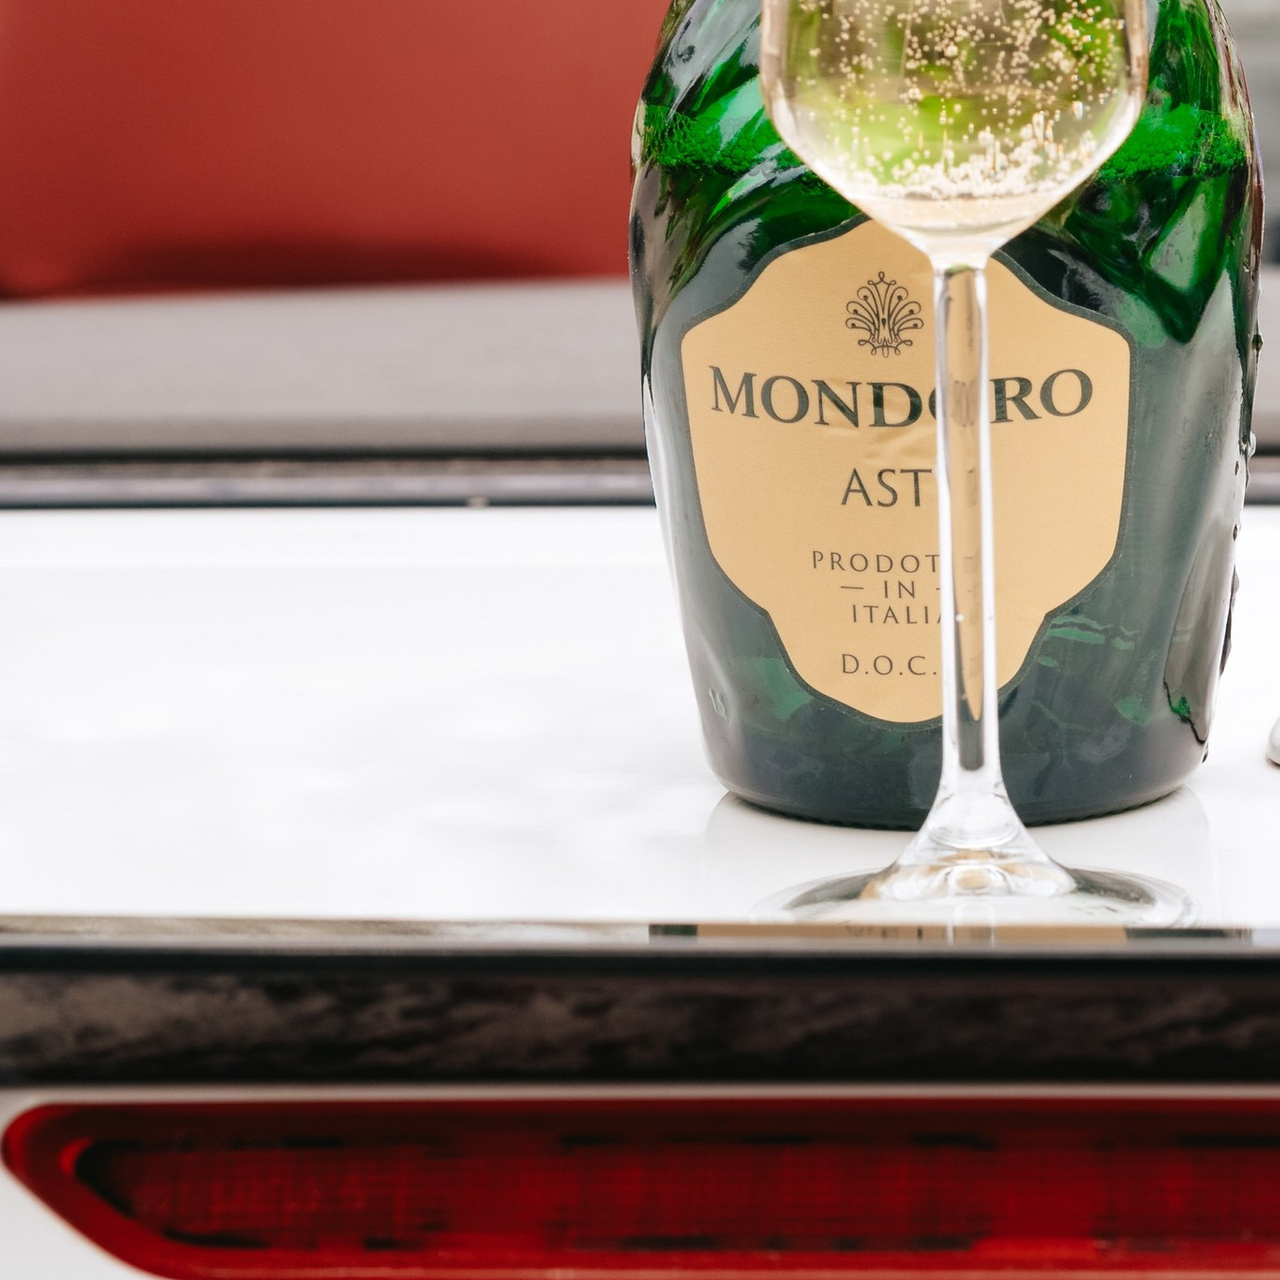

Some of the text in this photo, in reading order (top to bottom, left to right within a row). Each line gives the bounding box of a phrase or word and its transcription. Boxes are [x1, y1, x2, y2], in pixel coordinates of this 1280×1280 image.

[708, 365, 1093, 429] MONDRO
[840, 467, 934, 507] AST
[811, 550, 941, 574] PRODOT
[883, 580, 916, 599] IN
[851, 604, 942, 625] ITALI
[841, 653, 938, 676] D.O.C.
